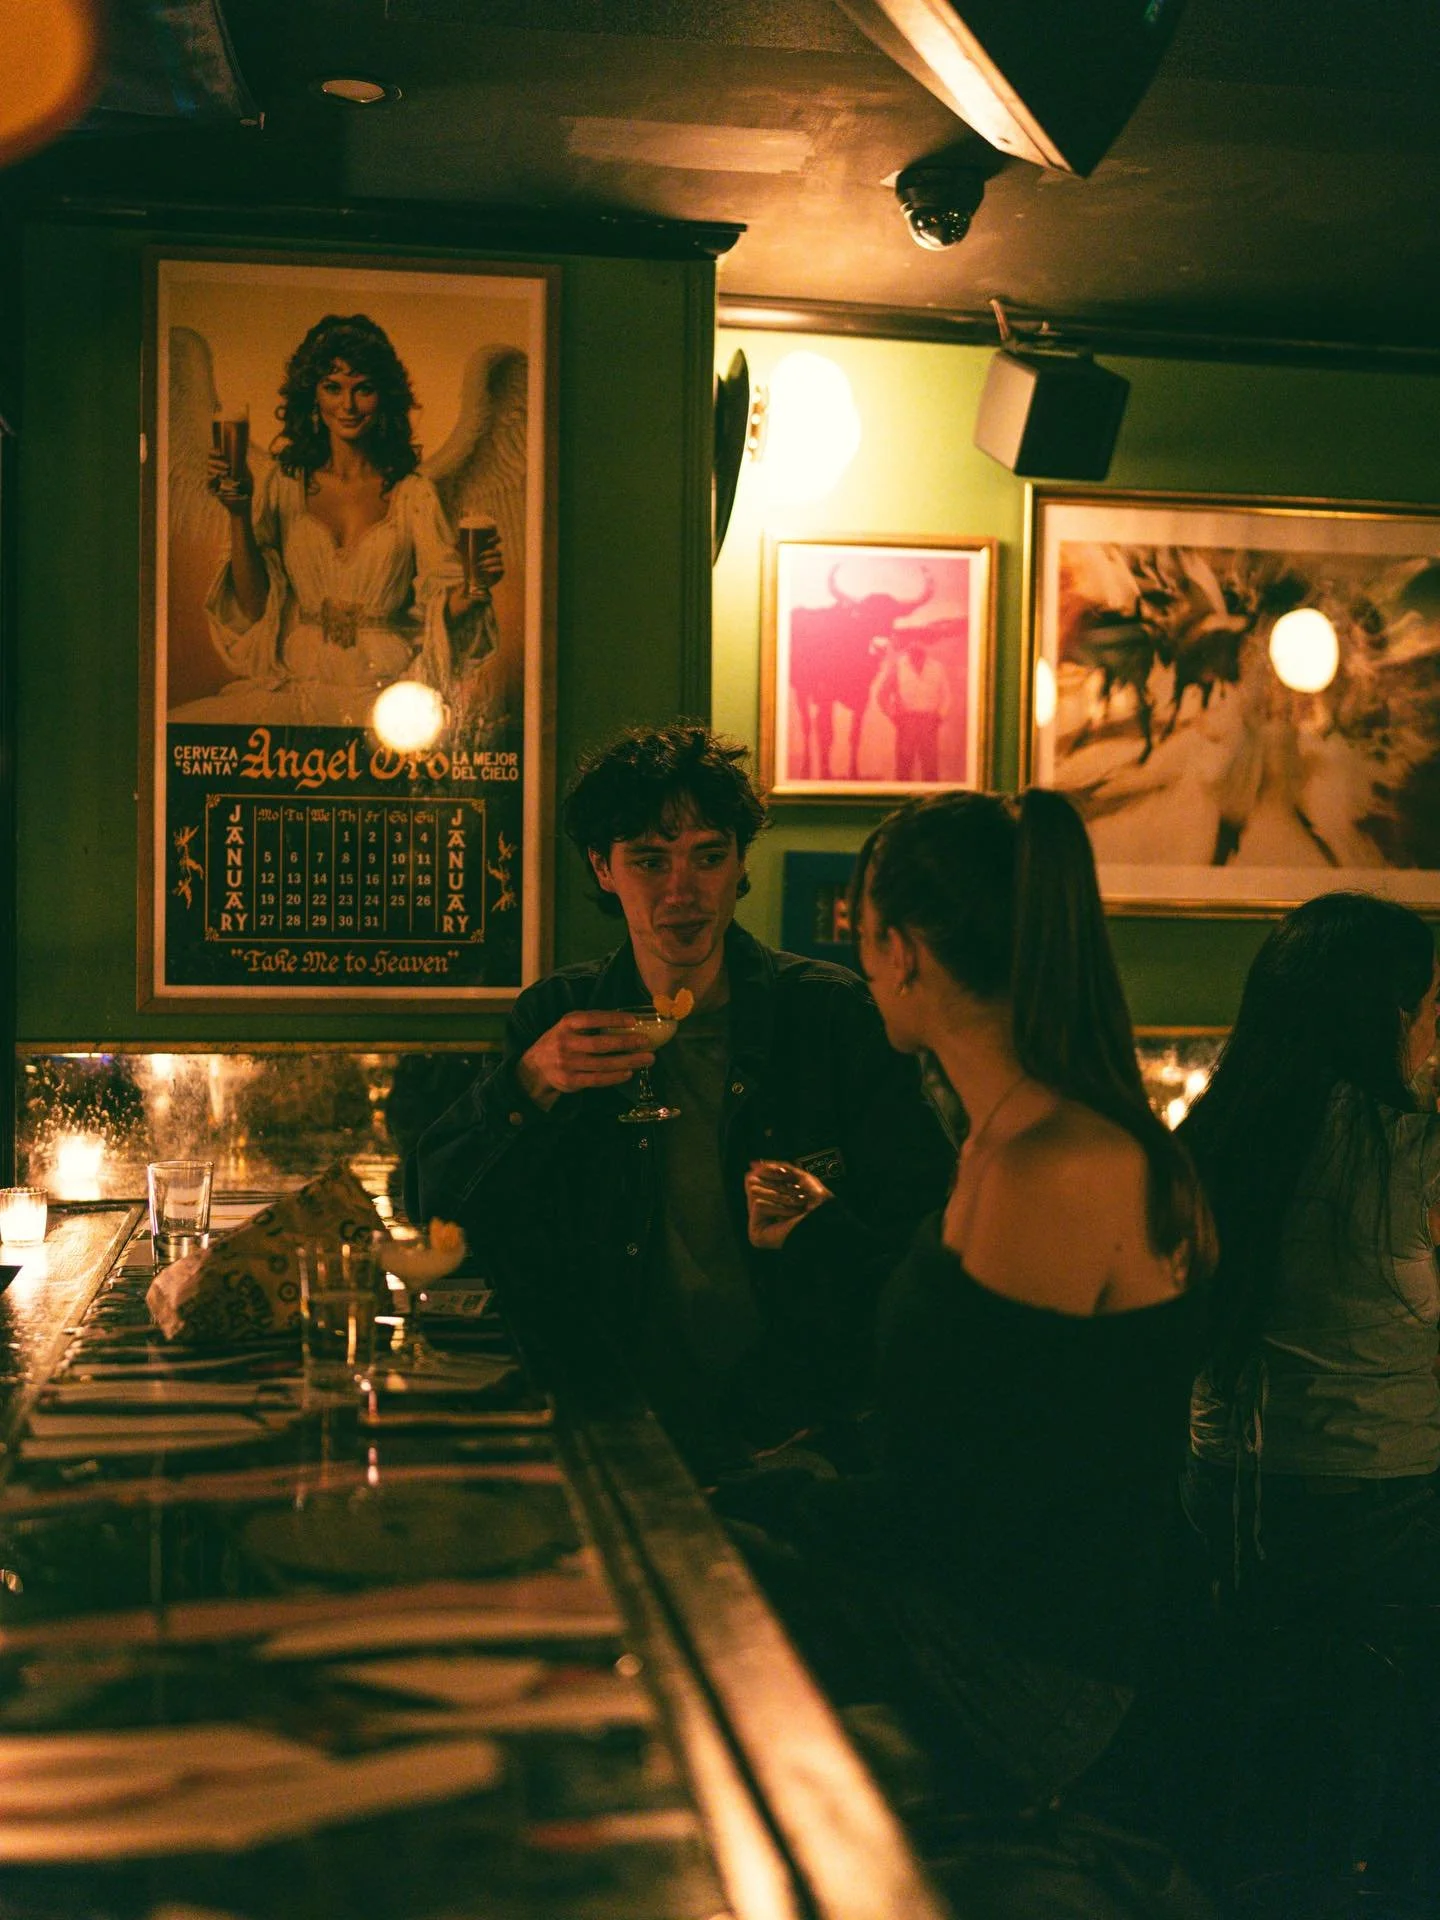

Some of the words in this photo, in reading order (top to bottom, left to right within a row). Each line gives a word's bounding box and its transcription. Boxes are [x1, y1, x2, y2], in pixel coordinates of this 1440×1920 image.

[174, 746, 237, 761] CERVEZA
[241, 727, 362, 790] Angel
[453, 752, 468, 766] LA
[474, 752, 516, 766] MEJOR
[176, 761, 237, 774] "SANTA"
[452, 766, 476, 779] DEL
[481, 766, 518, 780] CIELO
[343, 830, 350, 843] 1
[368, 830, 377, 843] 2
[394, 831, 403, 844] 3
[419, 831, 429, 844] 4
[263, 850, 272, 864] 5
[289, 851, 299, 864] 6
[316, 851, 324, 864] 7
[341, 851, 351, 864] 8
[367, 852, 377, 865] 9
[392, 852, 409, 865] 10
[415, 852, 431, 865] 11
[261, 871, 275, 884] 12
[287, 872, 302, 885] 13
[313, 872, 328, 885] 14
[339, 873, 354, 885] 15
[365, 873, 380, 886] 16
[391, 873, 408, 886] 17
[417, 874, 432, 886] 18
[261, 893, 275, 905] 19
[286, 893, 302, 905] 20
[312, 893, 327, 907] 22
[338, 894, 353, 906] 23
[364, 895, 380, 907] 24
[390, 894, 406, 907] 25
[416, 895, 432, 907] 26
[259, 914, 275, 926] 27
[285, 914, 301, 927] 28
[311, 914, 328, 927] 29
[338, 915, 353, 927] 30
[364, 915, 379, 928] 31
[301, 951, 340, 973] Me
[344, 951, 367, 973] to
